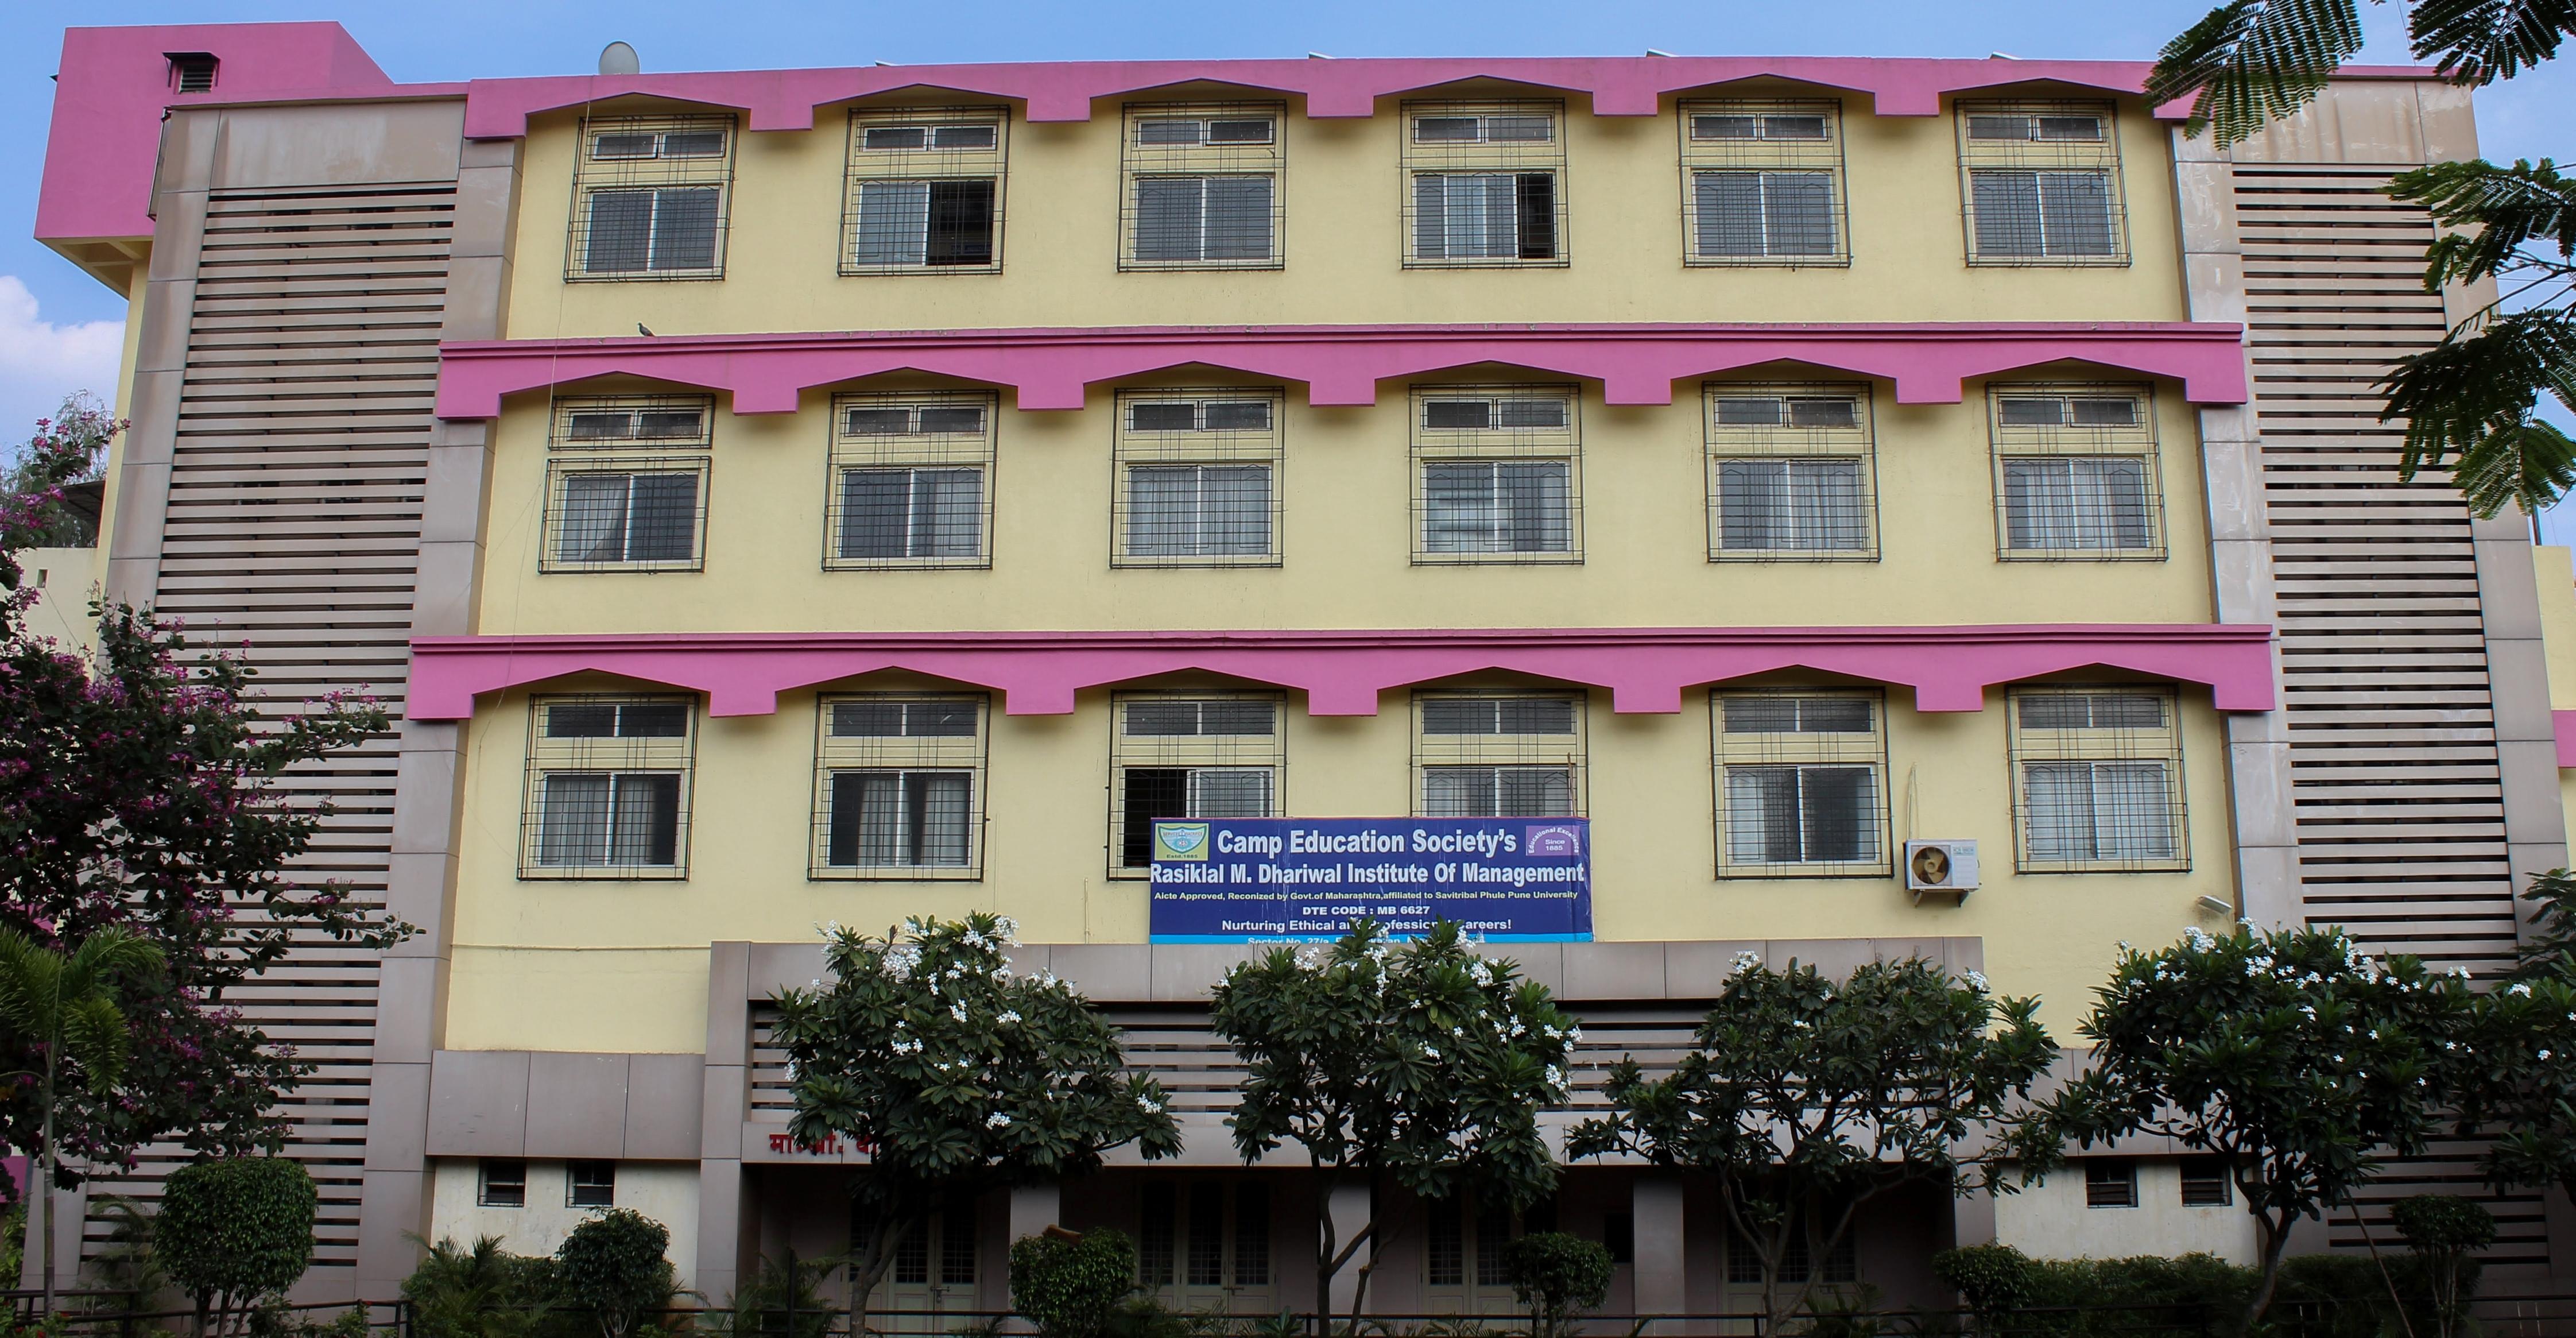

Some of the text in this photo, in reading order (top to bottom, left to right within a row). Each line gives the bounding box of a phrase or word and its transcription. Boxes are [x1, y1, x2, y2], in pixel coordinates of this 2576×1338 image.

[1218, 828, 1517, 859] Camp Education Society's
[1528, 827, 1579, 853] Educational Excellence
[1150, 862, 1585, 887] Rasiklal M. Dhariwal Institute Of Management
[1179, 892, 1226, 901] Approved,
[1276, 892, 1288, 902] by
[1533, 891, 1578, 900] University
[1303, 907, 1327, 915] DTE
[1331, 906, 1366, 915] CODE
[1377, 906, 1397, 914] MB
[1400, 906, 1430, 914] 6627
[1222, 920, 1285, 933] Nurturing
[1289, 920, 1334, 930] Ethical
[1458, 919, 1512, 930] areers!
